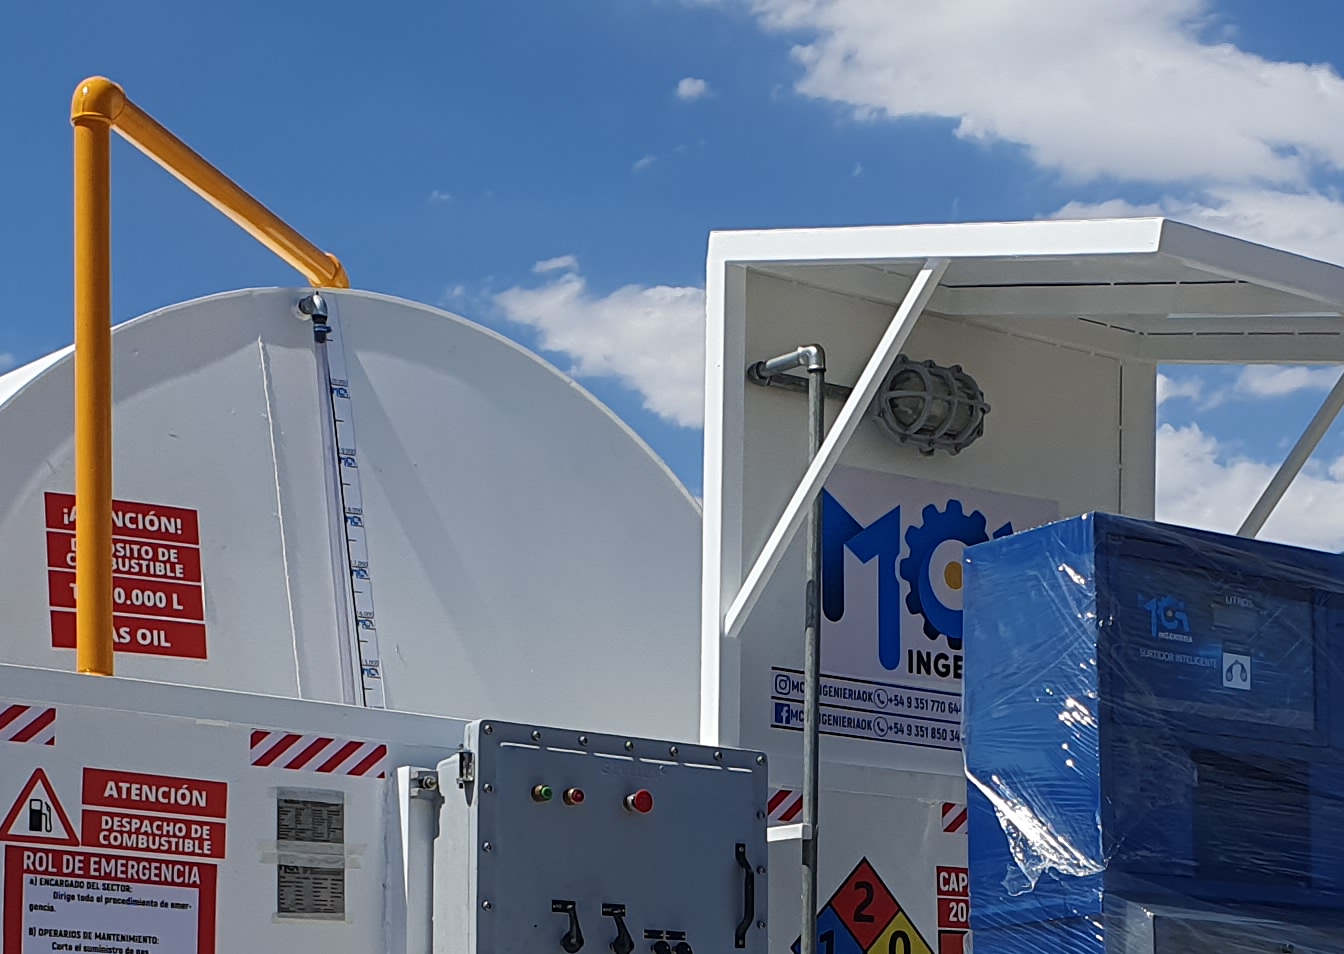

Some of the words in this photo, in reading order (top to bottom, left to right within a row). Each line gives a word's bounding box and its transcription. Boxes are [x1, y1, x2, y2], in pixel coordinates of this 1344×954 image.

[63, 506, 182, 534] ¡ANCIÓN!
[66, 553, 184, 577] CBUSTIBLE
[158, 549, 178, 562] DE
[114, 588, 166, 608] 0.000
[172, 594, 183, 610] L
[112, 626, 130, 643] AS
[137, 628, 171, 647] OIL
[908, 649, 963, 679] INGE
[888, 695, 903, 707] +54
[907, 697, 912, 707] 9
[914, 698, 929, 710] 351
[930, 699, 945, 713] 770
[948, 701, 961, 714] 64
[888, 722, 904, 734] +54
[907, 725, 912, 735] 9
[914, 725, 929, 738] 351
[931, 727, 947, 740] 850
[950, 729, 961, 741] 34
[104, 781, 206, 807] ATENCIÓN
[102, 816, 186, 837] DESPACHO
[191, 825, 210, 839] DE
[99, 833, 211, 854] COMBUSTIBLE
[23, 851, 57, 872] ROL
[63, 855, 84, 875] DE
[90, 857, 201, 884] EMERGENCIA
[40, 878, 84, 889] ENCARGADO
[87, 882, 100, 891] DEL
[102, 883, 132, 893] SECTOR:
[53, 892, 75, 902] Dirige
[77, 893, 94, 902] todo
[160, 900, 168, 908] de
[853, 881, 875, 923] 2
[949, 902, 967, 922] 20
[38, 928, 81, 939] OPERARIOS
[83, 931, 92, 940] DE
[95, 932, 160, 944] MANTENIMIENTO:
[75, 942, 81, 951] el
[125, 946, 134, 954] de
